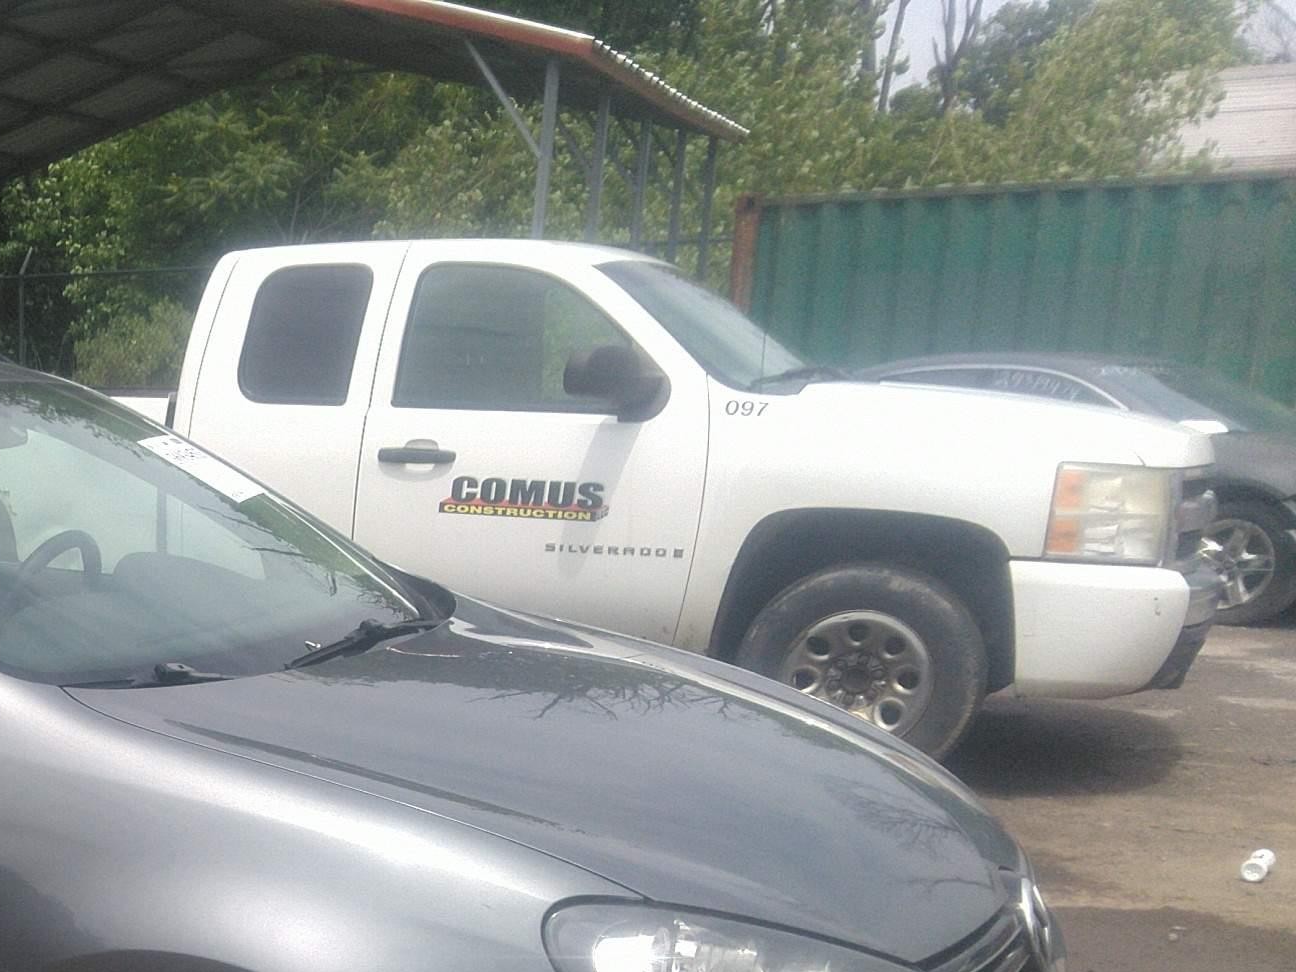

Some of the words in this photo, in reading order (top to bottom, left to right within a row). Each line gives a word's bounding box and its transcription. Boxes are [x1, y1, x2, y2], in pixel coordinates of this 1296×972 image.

[725, 399, 769, 417] 097
[451, 475, 605, 509] COMUS
[442, 504, 592, 521] CONSTRUCTION
[545, 542, 667, 558] SILVERADO
